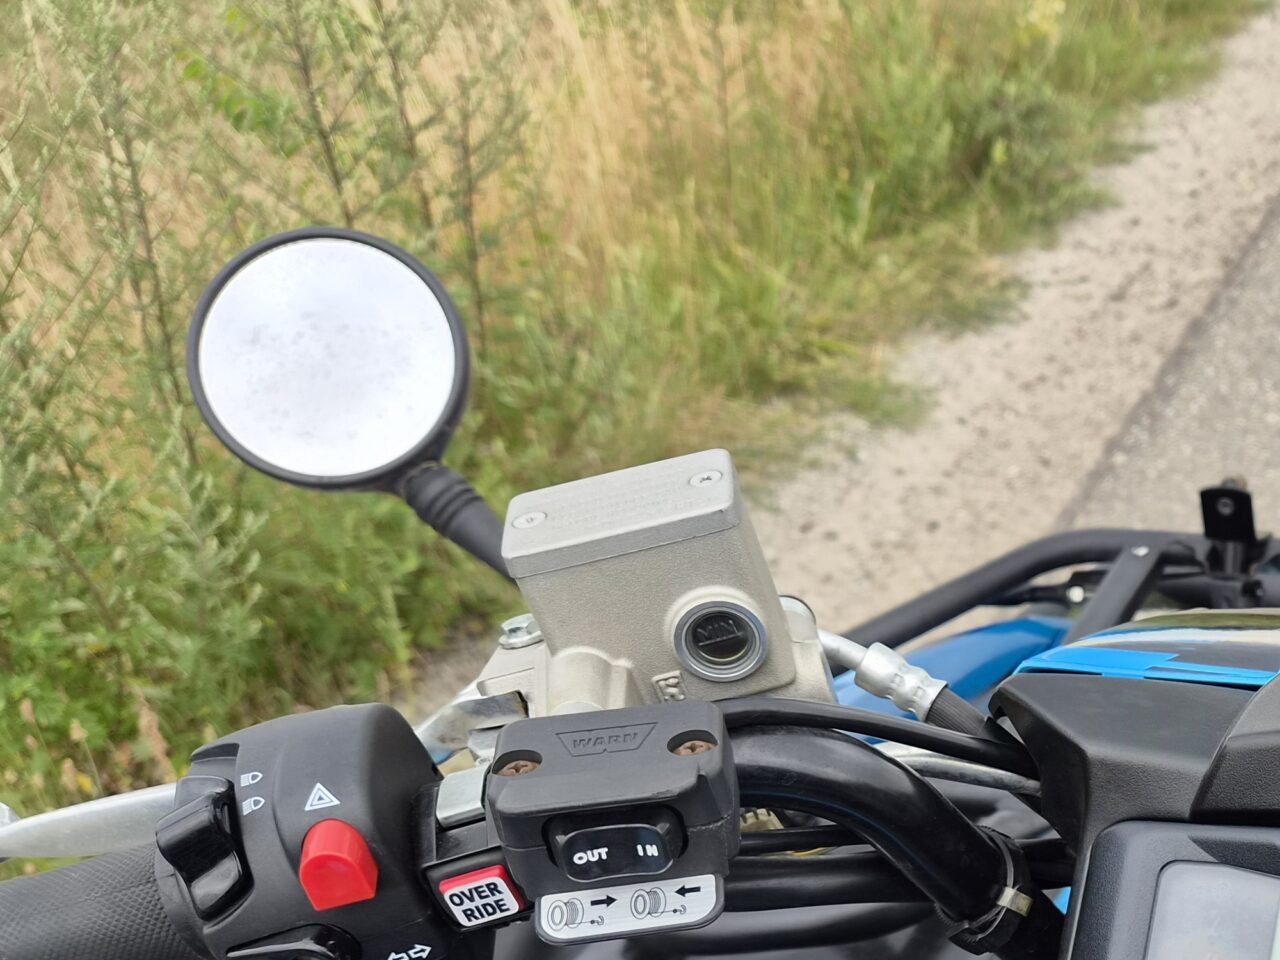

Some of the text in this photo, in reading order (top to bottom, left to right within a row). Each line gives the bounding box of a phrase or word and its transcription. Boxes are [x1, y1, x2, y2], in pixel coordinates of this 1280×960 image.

[572, 732, 640, 749] WARN
[572, 847, 609, 865] OUT
[636, 844, 659, 857] IN
[448, 881, 505, 907] OVER
[461, 898, 511, 923] RIDE
